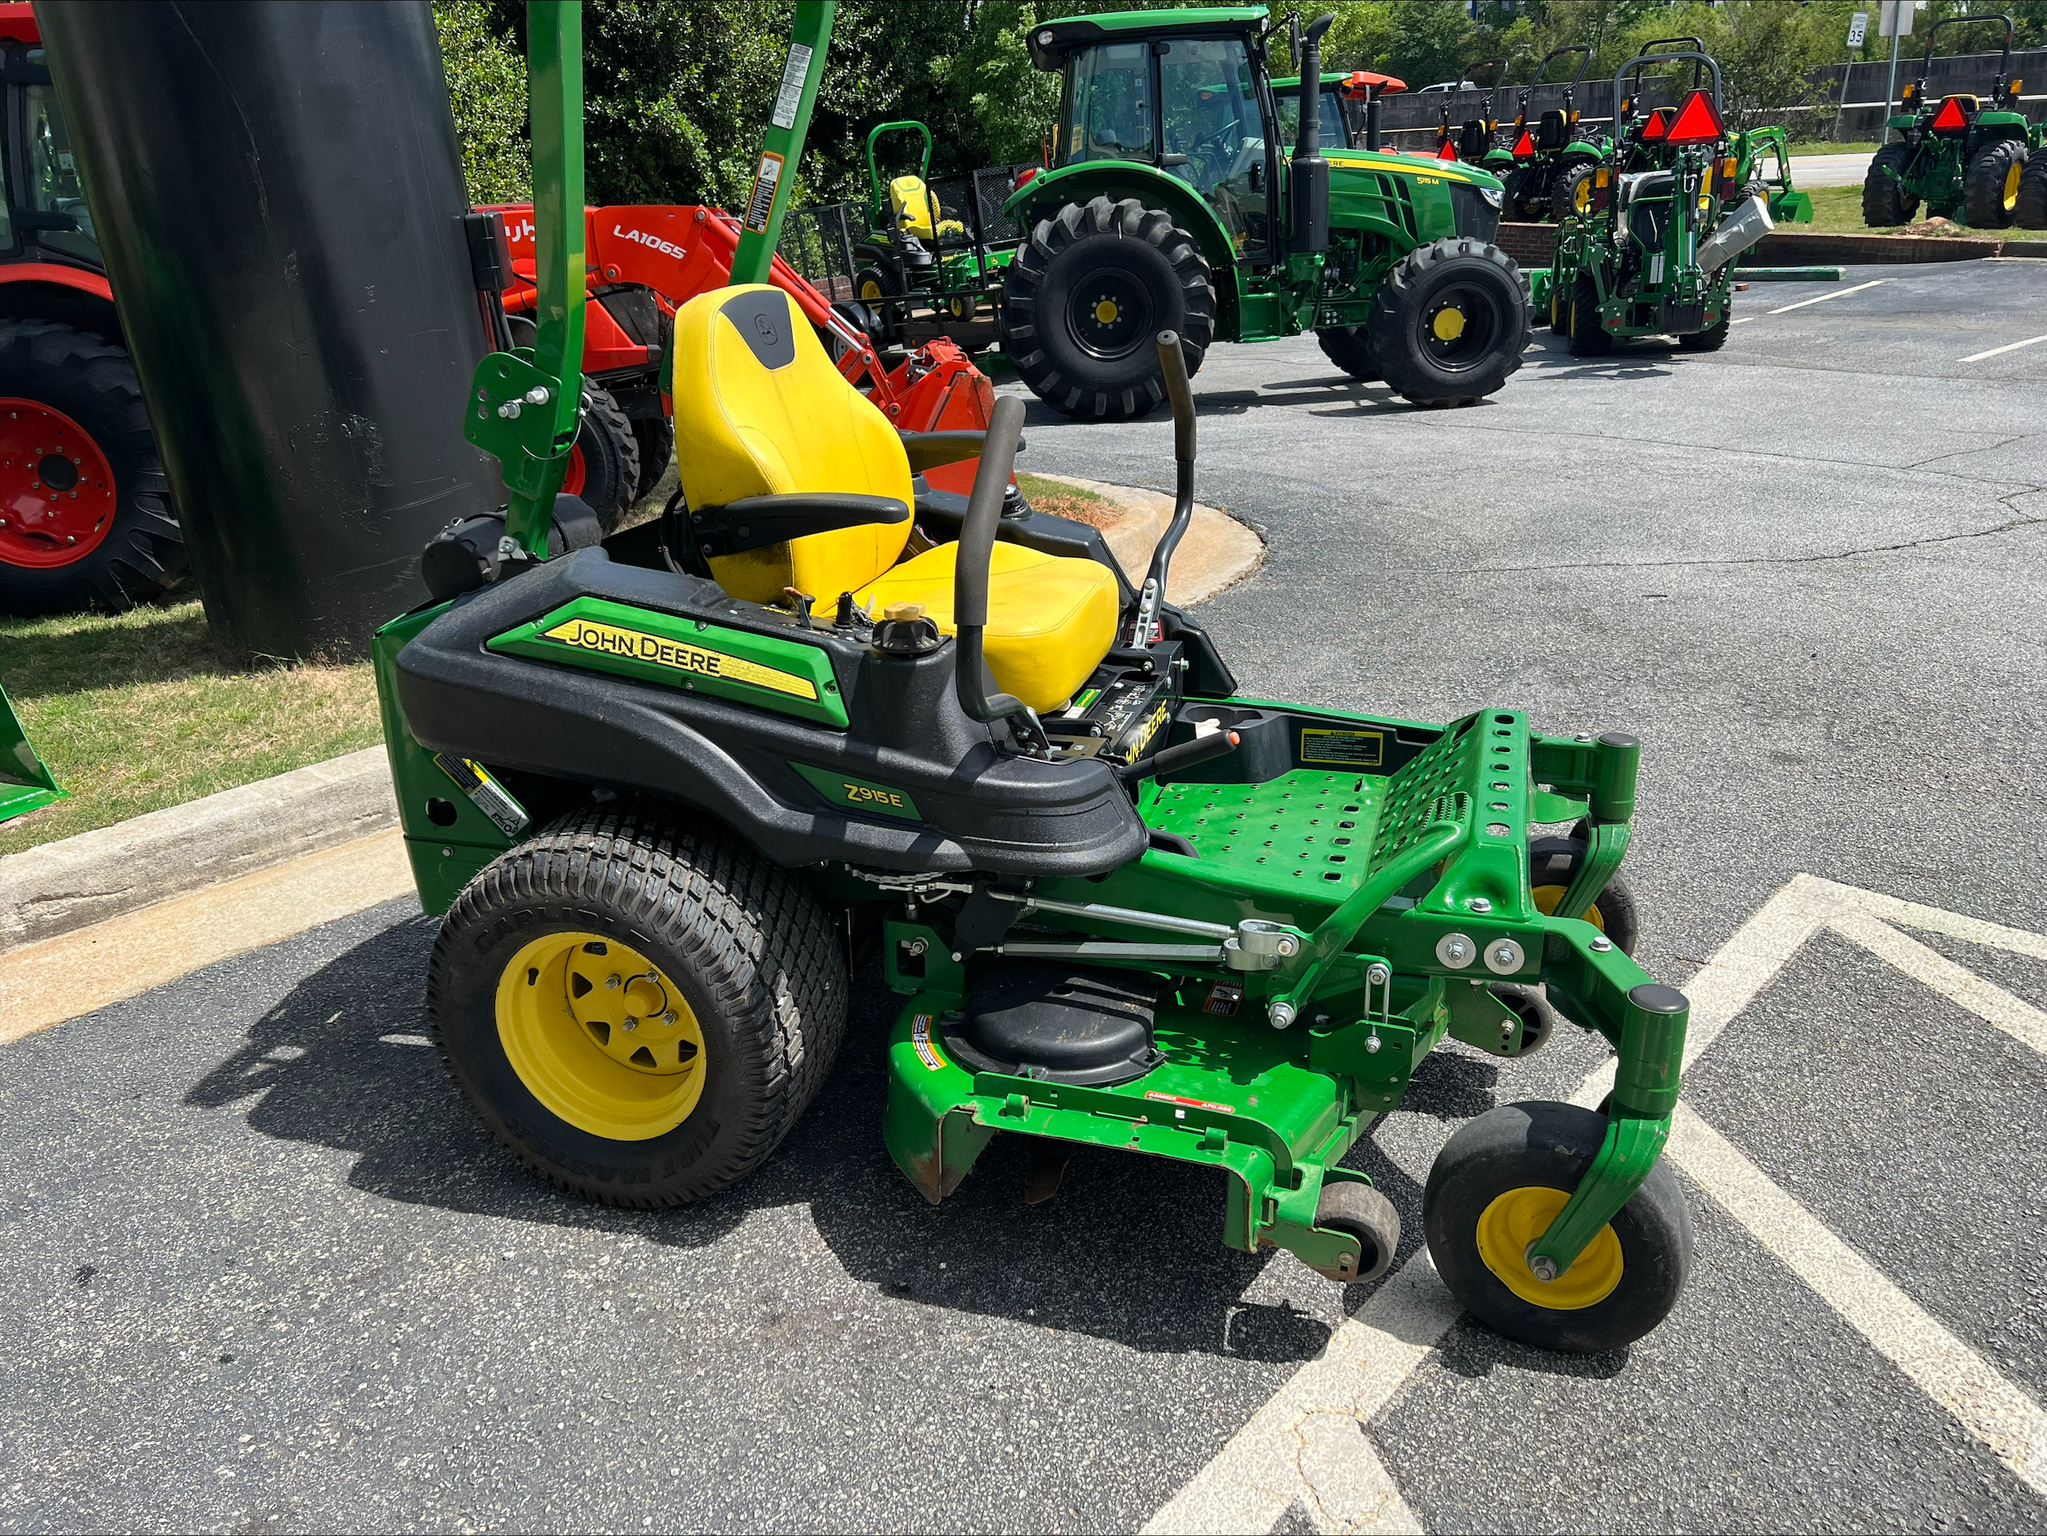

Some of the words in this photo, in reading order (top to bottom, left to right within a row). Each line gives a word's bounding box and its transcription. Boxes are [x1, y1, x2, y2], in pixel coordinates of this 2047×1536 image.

[1849, 30, 1863, 42] 35
[1432, 178, 1440, 186] M
[613, 224, 687, 260] LA1065
[569, 623, 634, 654] JOHN
[640, 637, 721, 674] DEERE
[1125, 736, 1140, 765] HN
[1139, 699, 1168, 752] DEERE
[475, 906, 651, 954] CARLISLE
[1207, 1103, 1232, 1113] PELIGRO
[507, 1116, 651, 1185] MASTER
[662, 1117, 721, 1180] TURF
